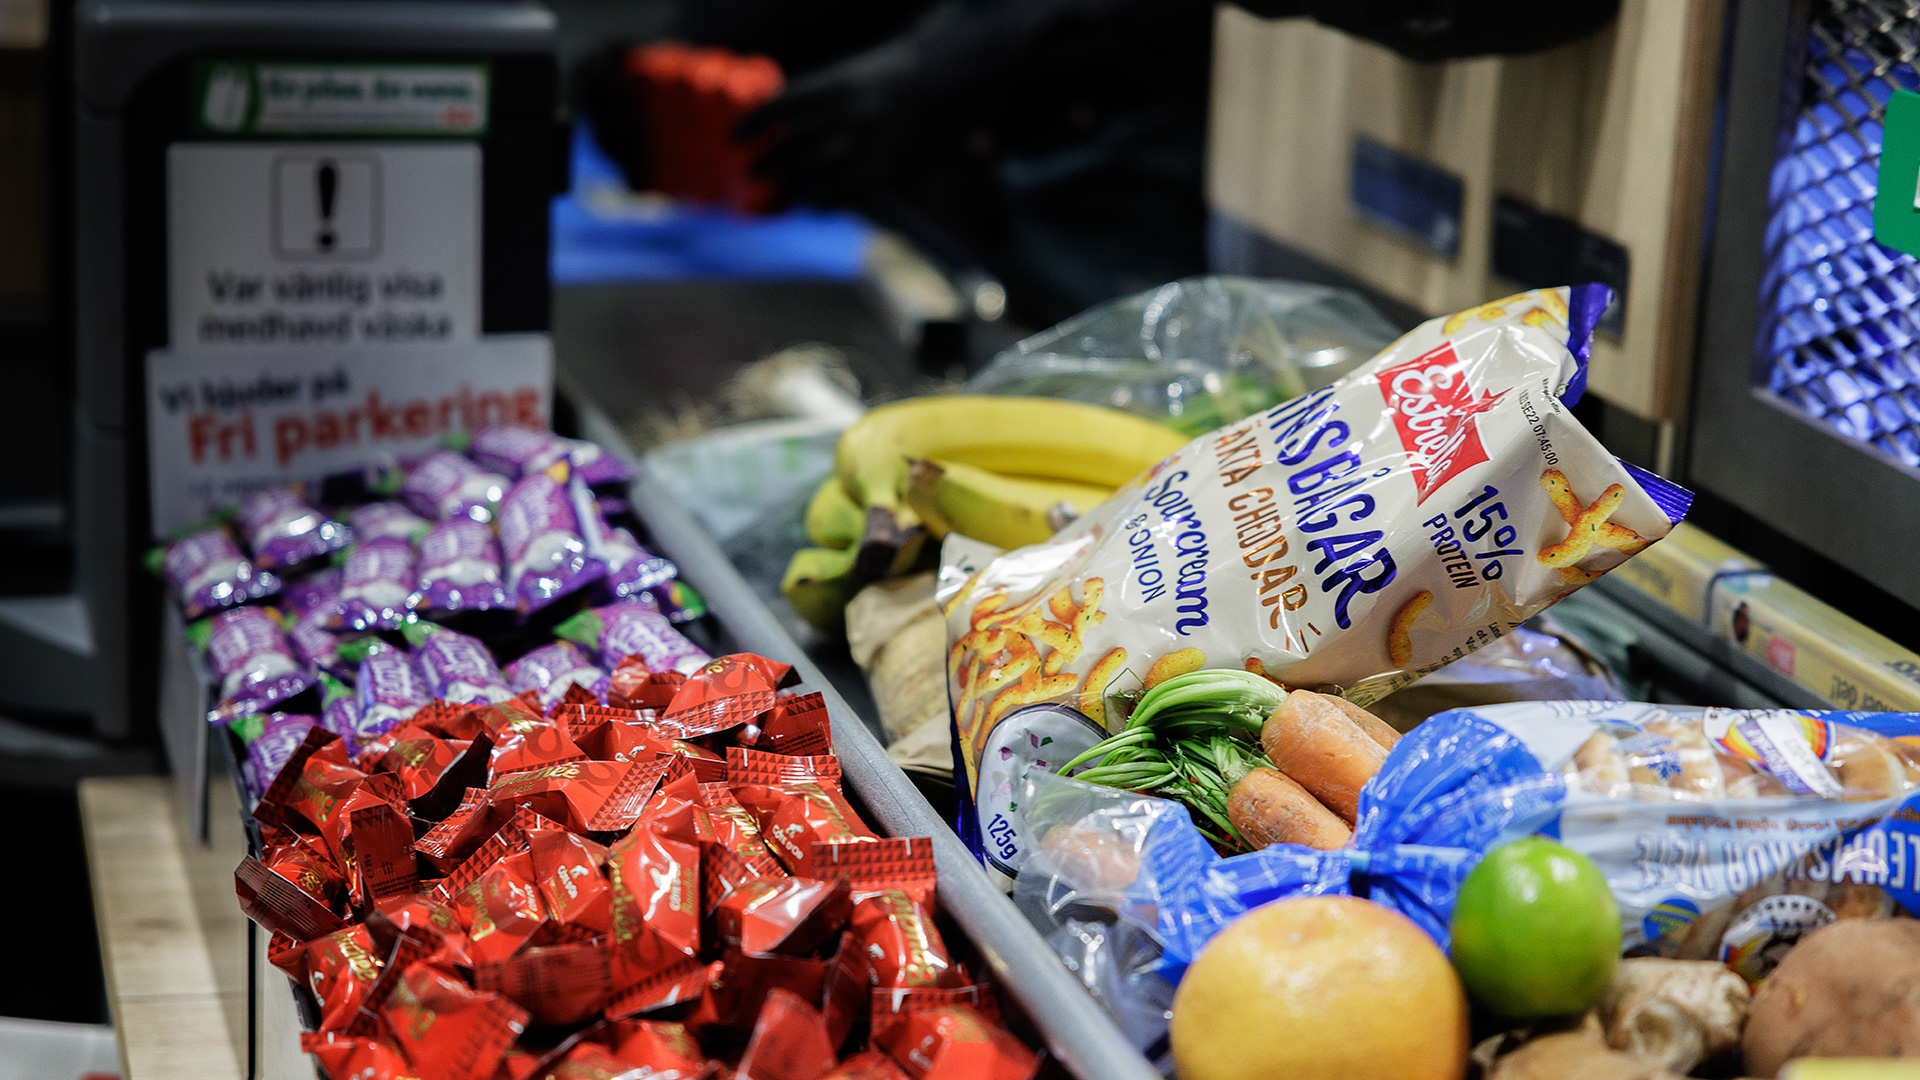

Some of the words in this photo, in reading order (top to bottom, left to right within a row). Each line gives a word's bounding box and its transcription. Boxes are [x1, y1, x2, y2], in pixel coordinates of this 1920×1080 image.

[187, 410, 258, 464] Fri
[273, 384, 542, 470] parkering
[1392, 364, 1467, 492] Estrella
[1532, 423, 1559, 466] 07:45:00
[1267, 385, 1398, 630] INSBÅGAR
[1422, 512, 1480, 589] PROTEIN
[1454, 484, 1524, 581] 15%
[1128, 528, 1167, 604] ONION
[1143, 470, 1211, 636] Sourcream
[986, 812, 1019, 861] 125g
